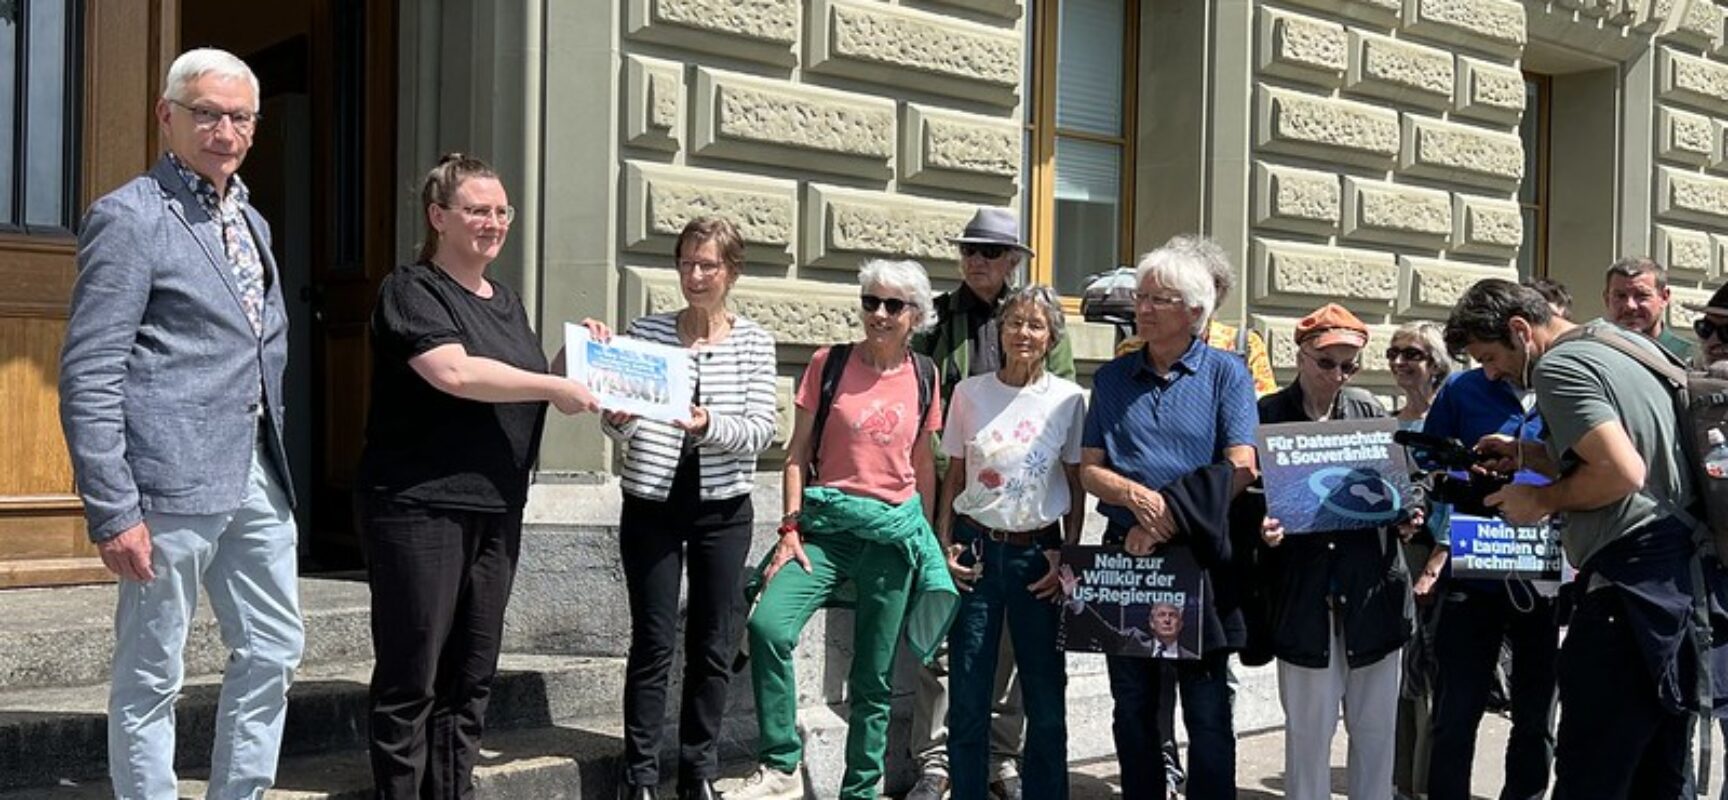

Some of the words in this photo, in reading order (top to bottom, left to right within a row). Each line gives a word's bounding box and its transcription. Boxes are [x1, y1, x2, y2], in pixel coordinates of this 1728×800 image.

[1266, 436, 1294, 451] Für
[1296, 430, 1393, 449] Datenschutz
[1276, 451, 1290, 466] &
[1291, 445, 1389, 465] Souveränität
[1477, 523, 1515, 539] Nein
[1518, 527, 1537, 539] zu
[1472, 539, 1532, 554] Launen
[1094, 553, 1132, 569] Nein
[1135, 557, 1164, 570] zur
[1083, 570, 1143, 585] Willkür
[1145, 571, 1175, 587] der
[1073, 587, 1186, 608] US-Regierung
